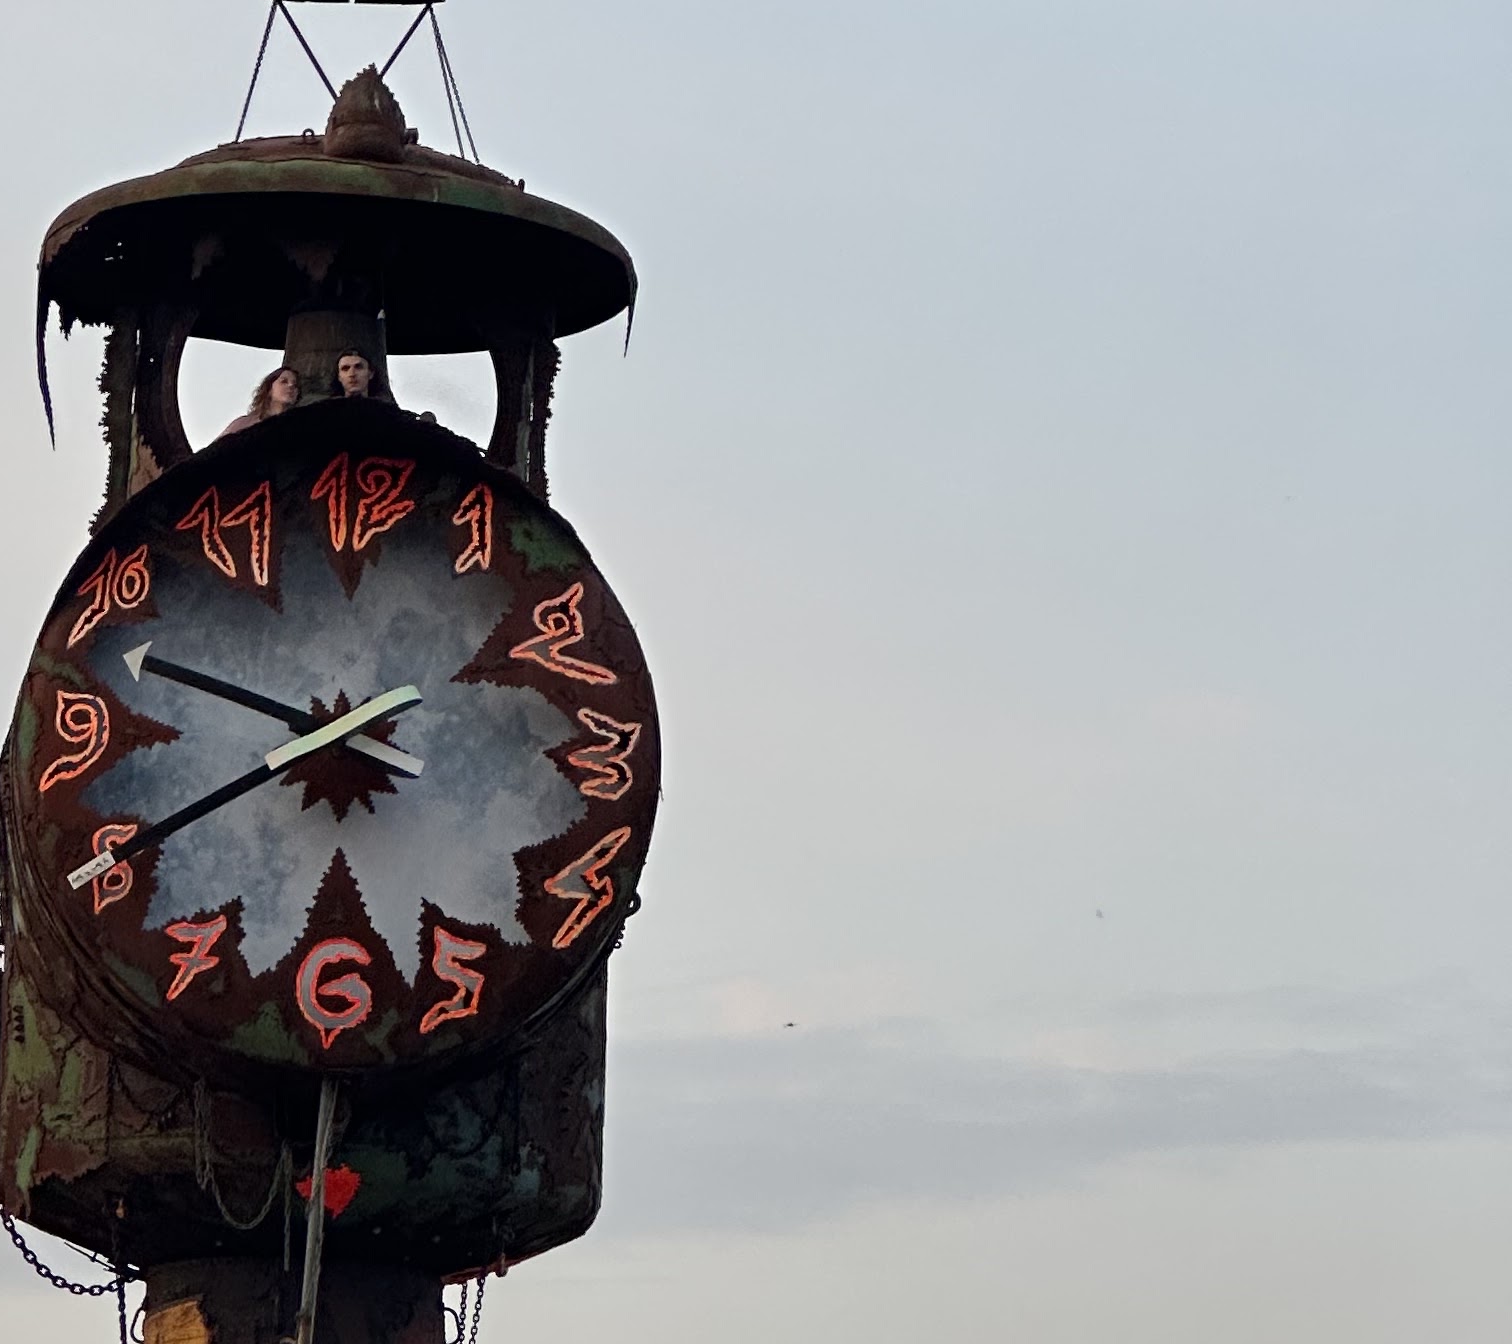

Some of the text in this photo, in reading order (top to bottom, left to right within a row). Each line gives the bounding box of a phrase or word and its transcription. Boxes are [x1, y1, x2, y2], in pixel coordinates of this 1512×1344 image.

[177, 481, 270, 585] 11
[313, 451, 415, 551] 12
[452, 483, 493, 573] 1
[66, 544, 149, 649] 10
[511, 582, 616, 685] 2
[40, 690, 110, 792] 9
[569, 708, 641, 801] 3
[92, 824, 138, 915] 8
[165, 915, 227, 1002] 7
[296, 937, 373, 1049] 6
[420, 926, 487, 1034] 5
